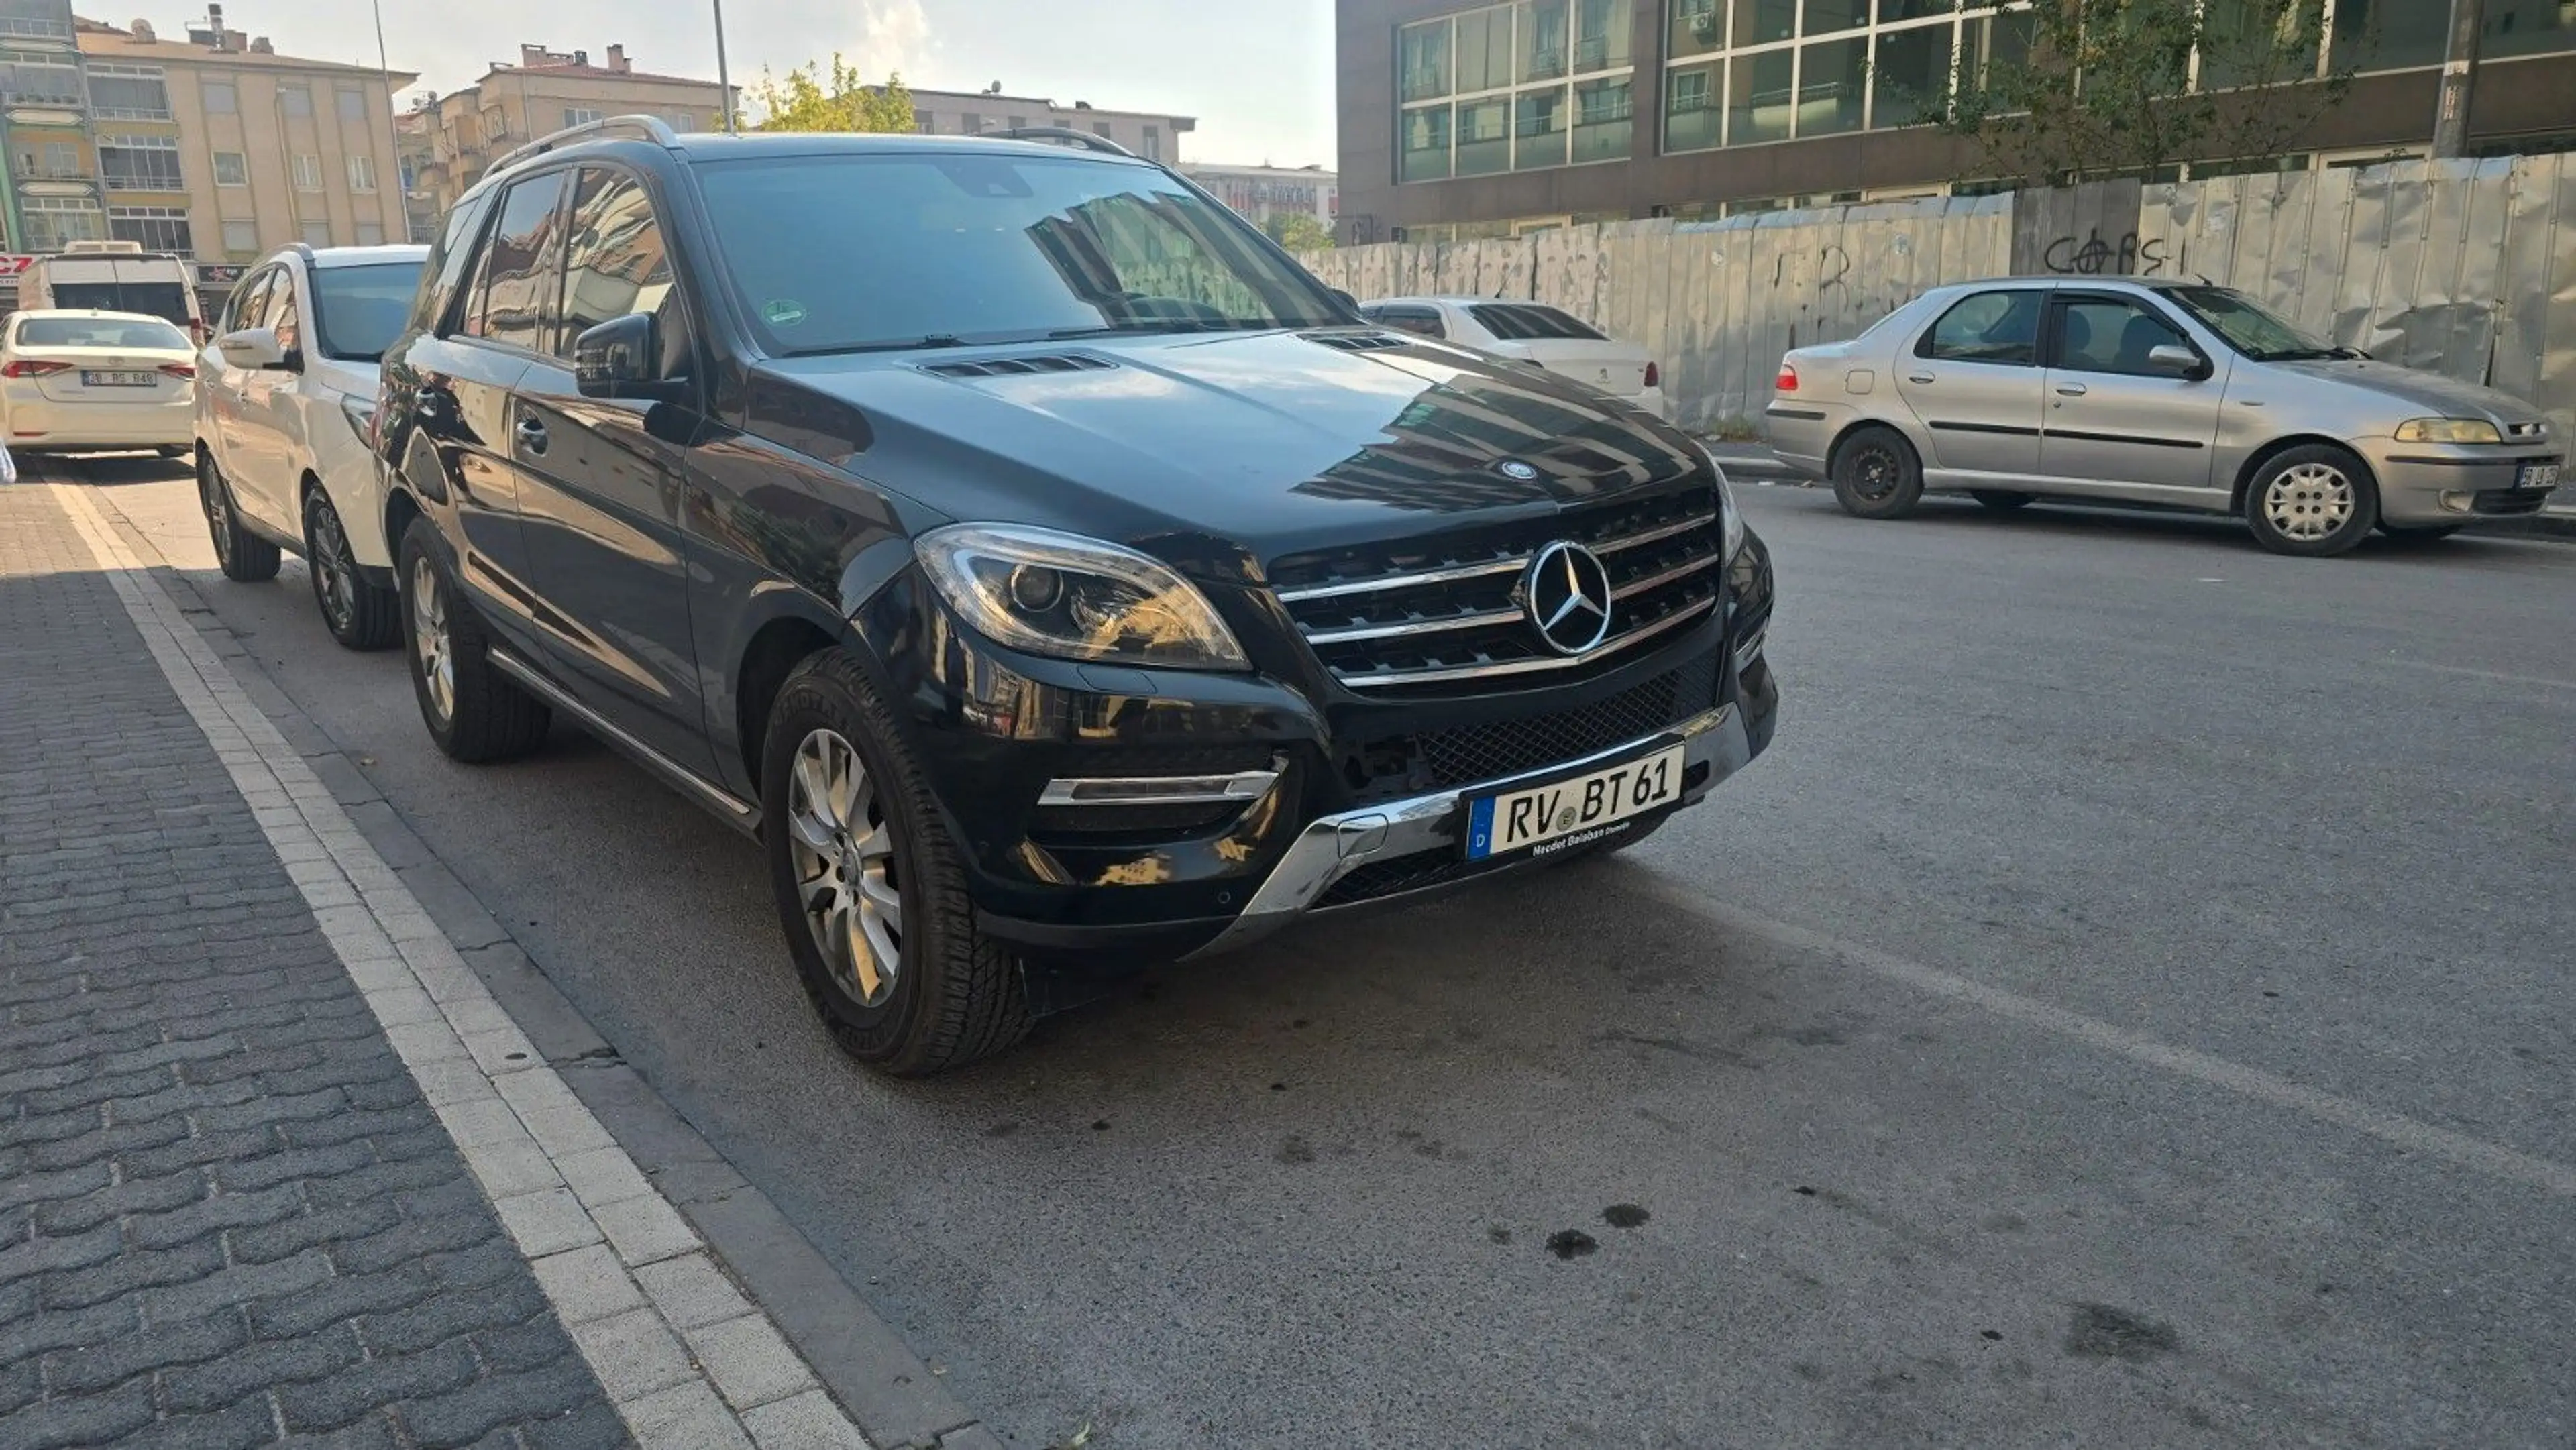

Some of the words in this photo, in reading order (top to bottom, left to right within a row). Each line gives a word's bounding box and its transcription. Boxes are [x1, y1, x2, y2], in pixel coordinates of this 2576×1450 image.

[1507, 789, 1561, 842] RV
[1580, 771, 1629, 823] BT
[1633, 757, 1668, 806] 61
[1476, 834, 1485, 848] D
